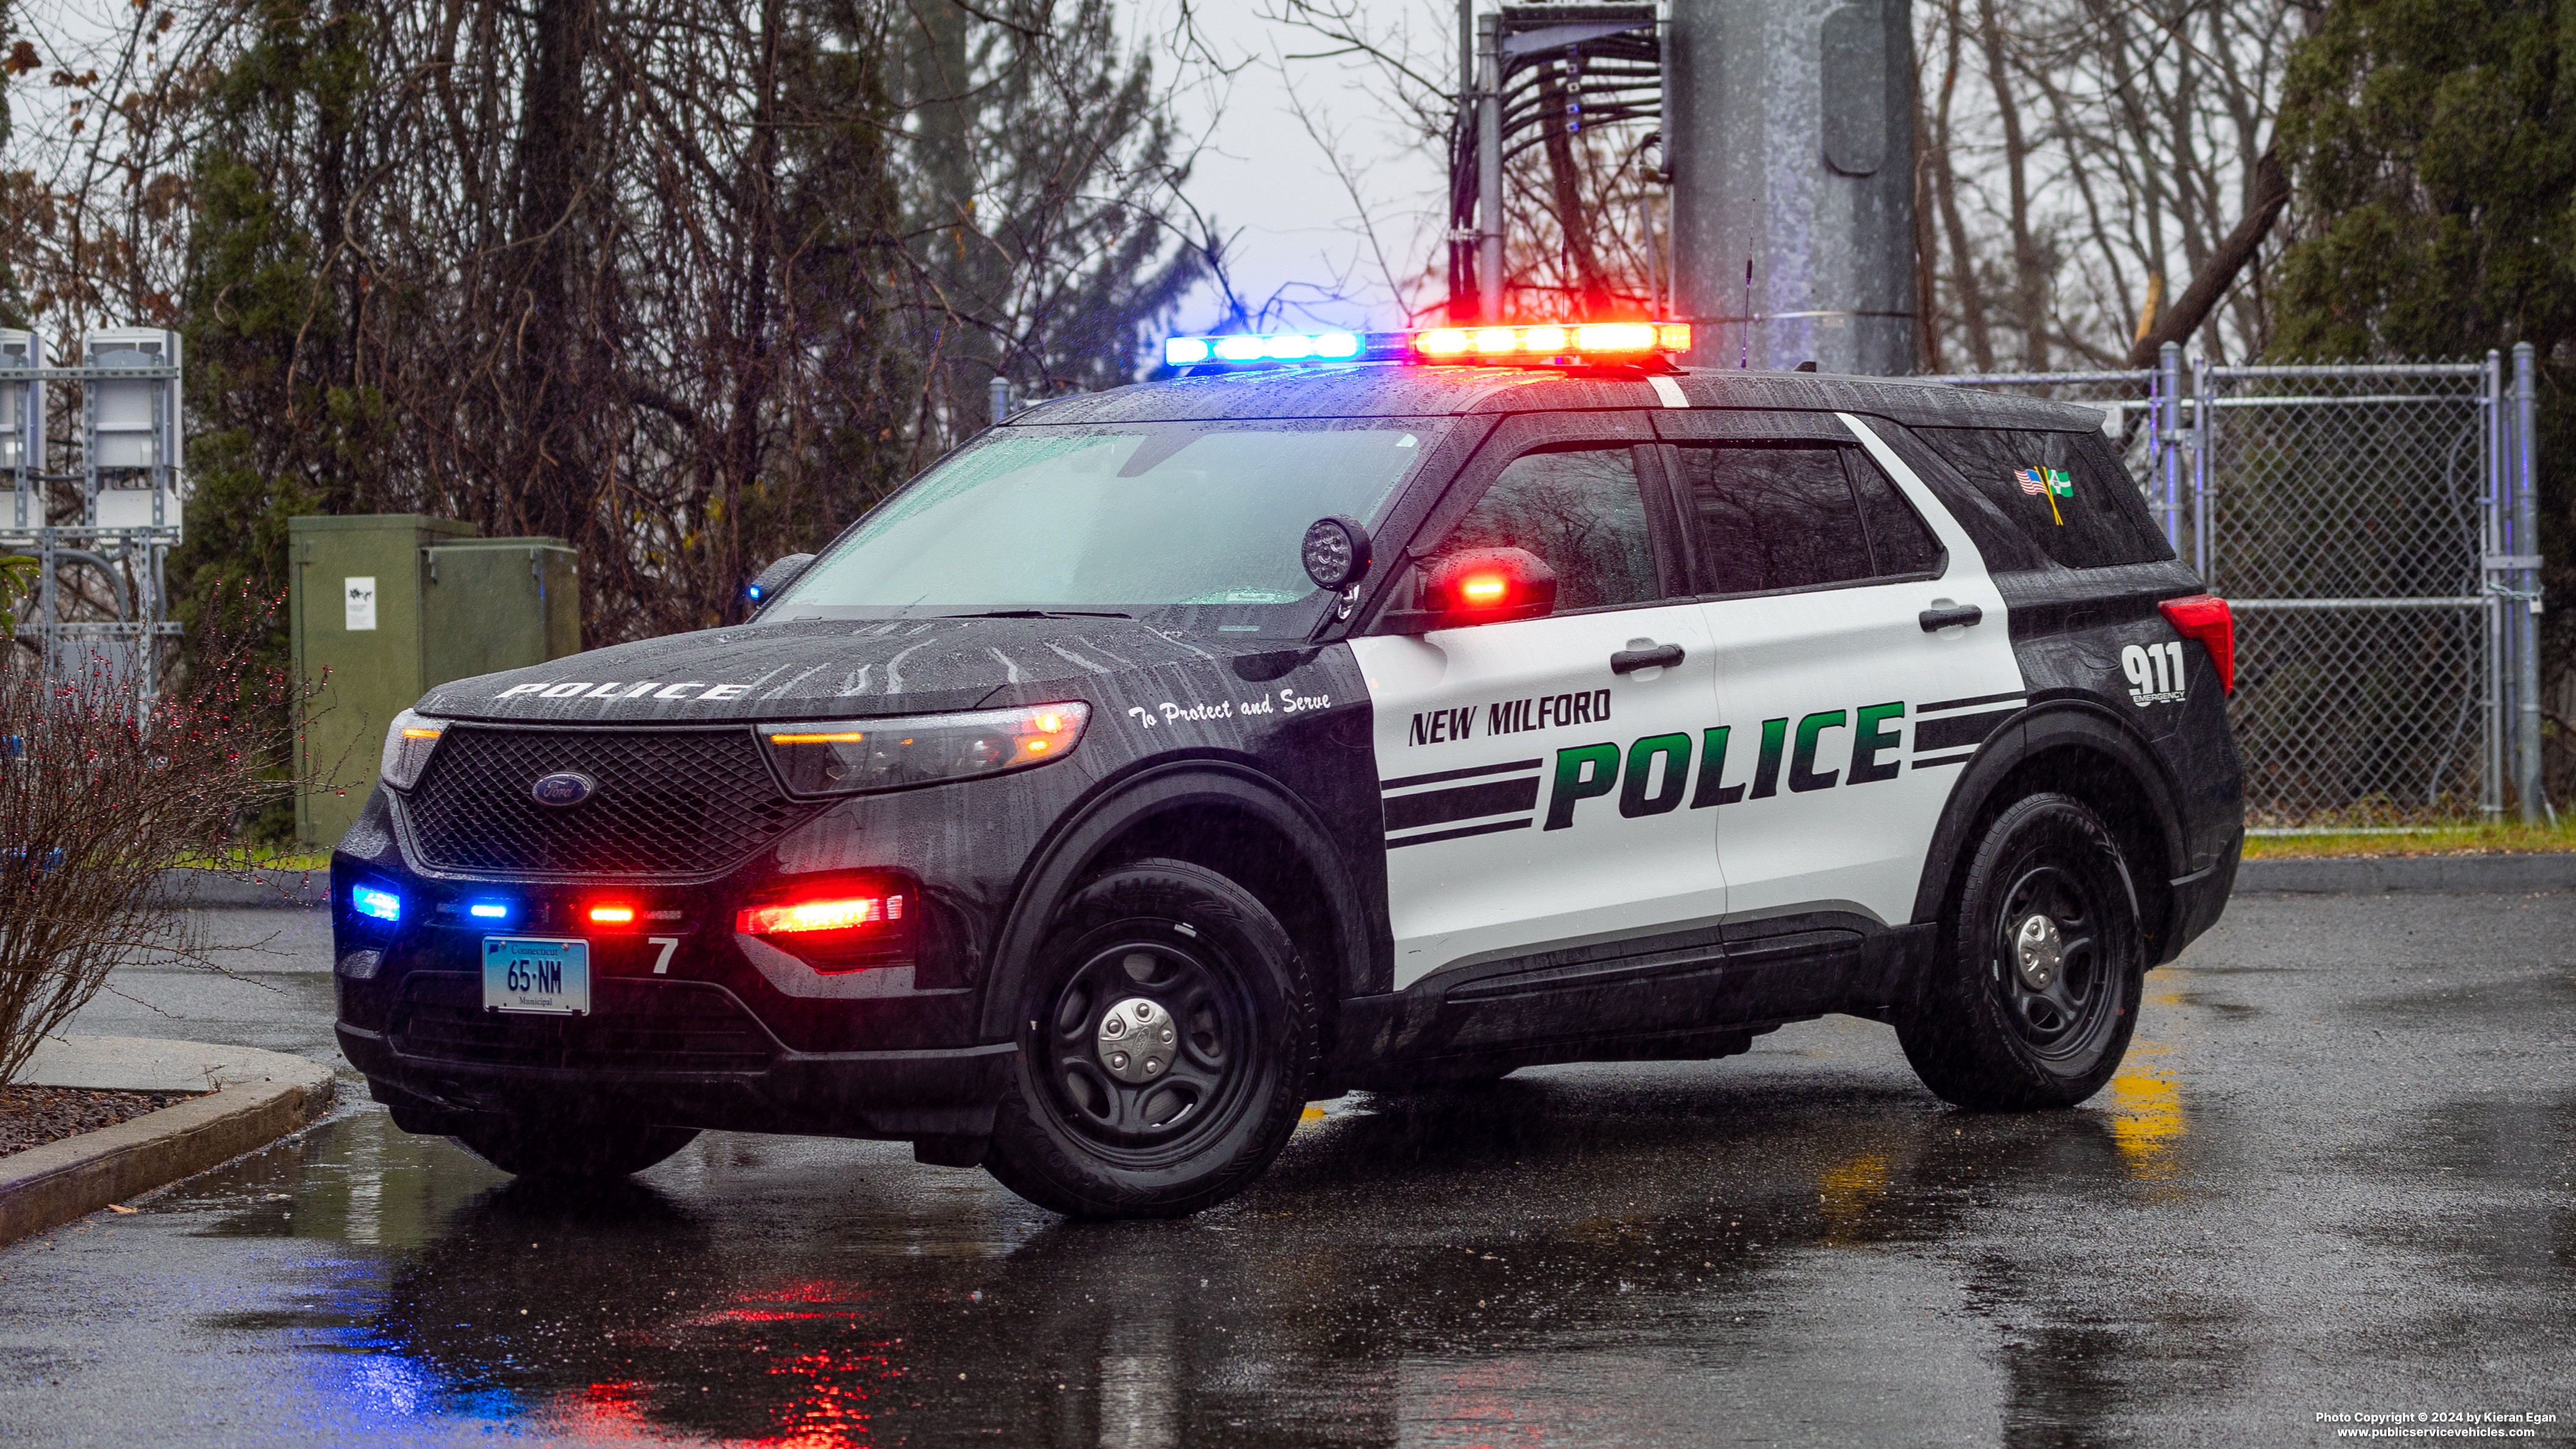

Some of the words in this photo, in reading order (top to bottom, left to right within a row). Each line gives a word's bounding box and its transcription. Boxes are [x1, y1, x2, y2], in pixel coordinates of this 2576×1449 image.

[494, 682, 752, 700] POLICE
[2122, 641, 2185, 707] 911
[1129, 706, 1157, 728] To
[1159, 702, 1232, 725] Protect
[1240, 694, 1274, 716] and
[1280, 688, 1331, 713] Serve
[2133, 691, 2185, 702] EMERGENCY
[1408, 706, 1478, 747] NEW
[1487, 689, 1610, 736] MILFORD
[1543, 700, 1905, 832] POLICE
[511, 945, 559, 956] Connecticut
[648, 937, 679, 974] 7
[519, 996, 553, 1006] Municipal
